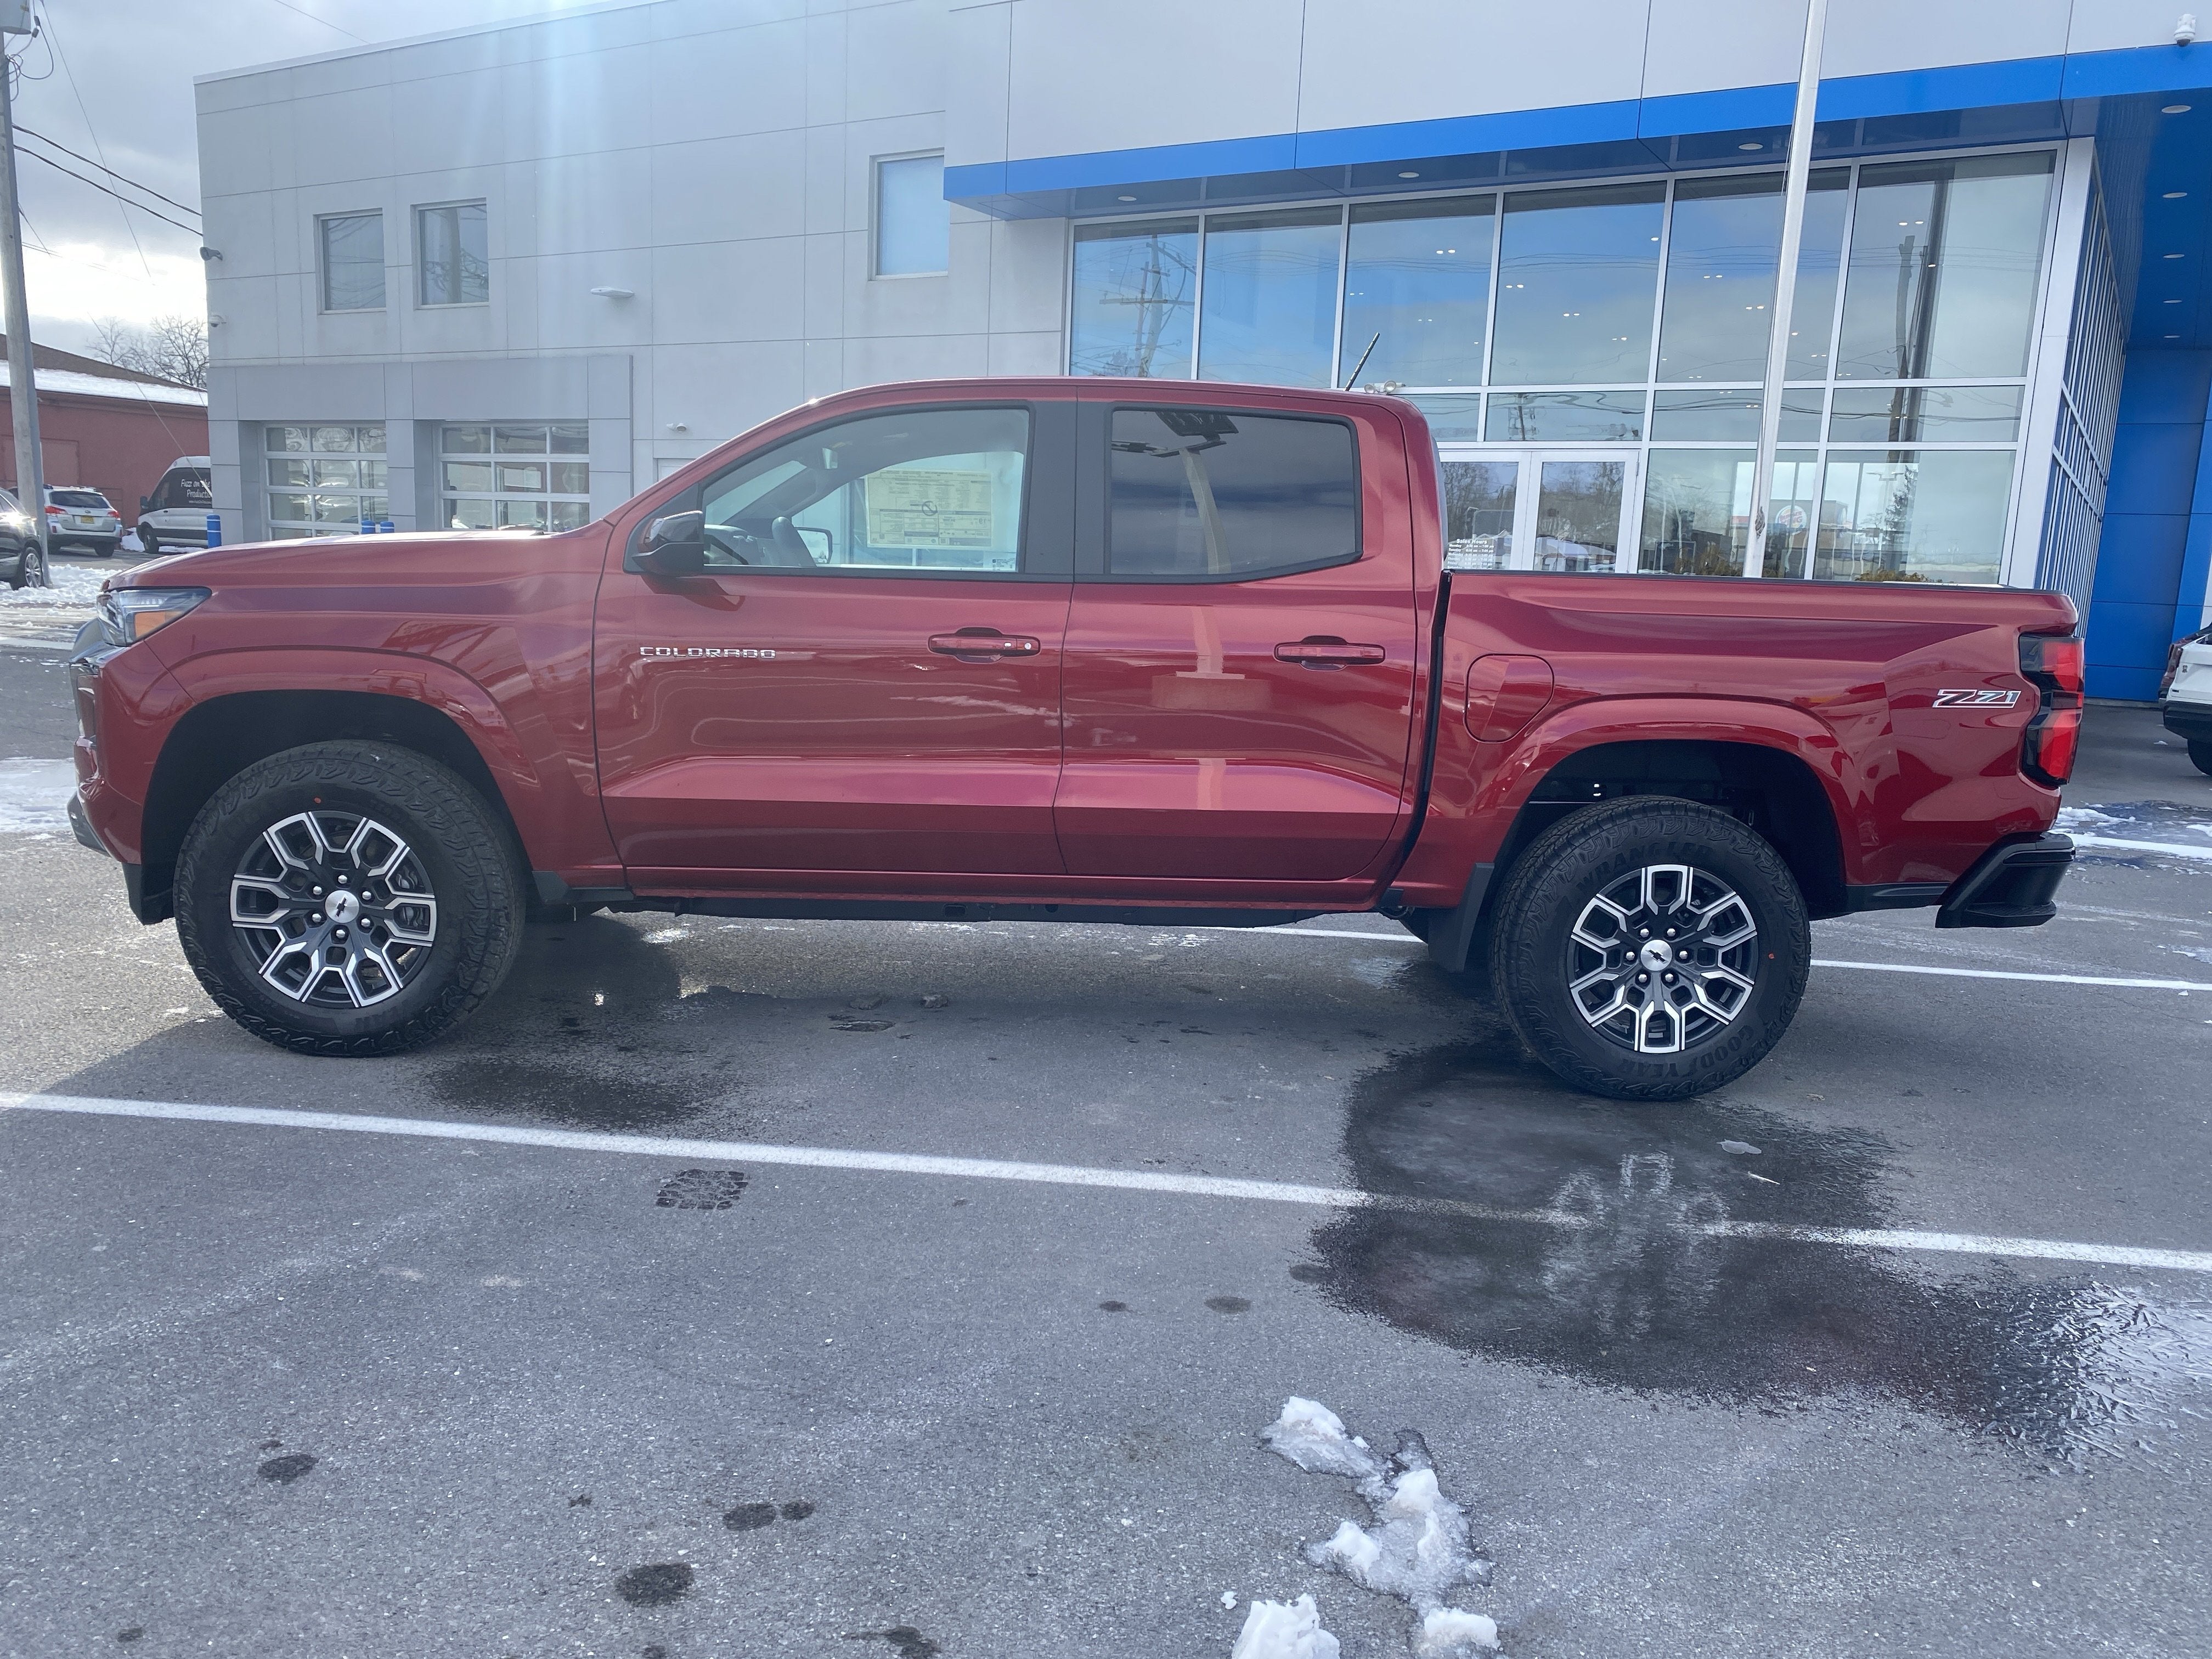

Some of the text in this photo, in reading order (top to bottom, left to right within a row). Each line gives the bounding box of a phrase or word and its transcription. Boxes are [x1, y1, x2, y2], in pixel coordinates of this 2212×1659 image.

[640, 647, 776, 659] COLORADO
[1932, 689, 2022, 708] Z71
[1576, 841, 1714, 894] WRANGLER
